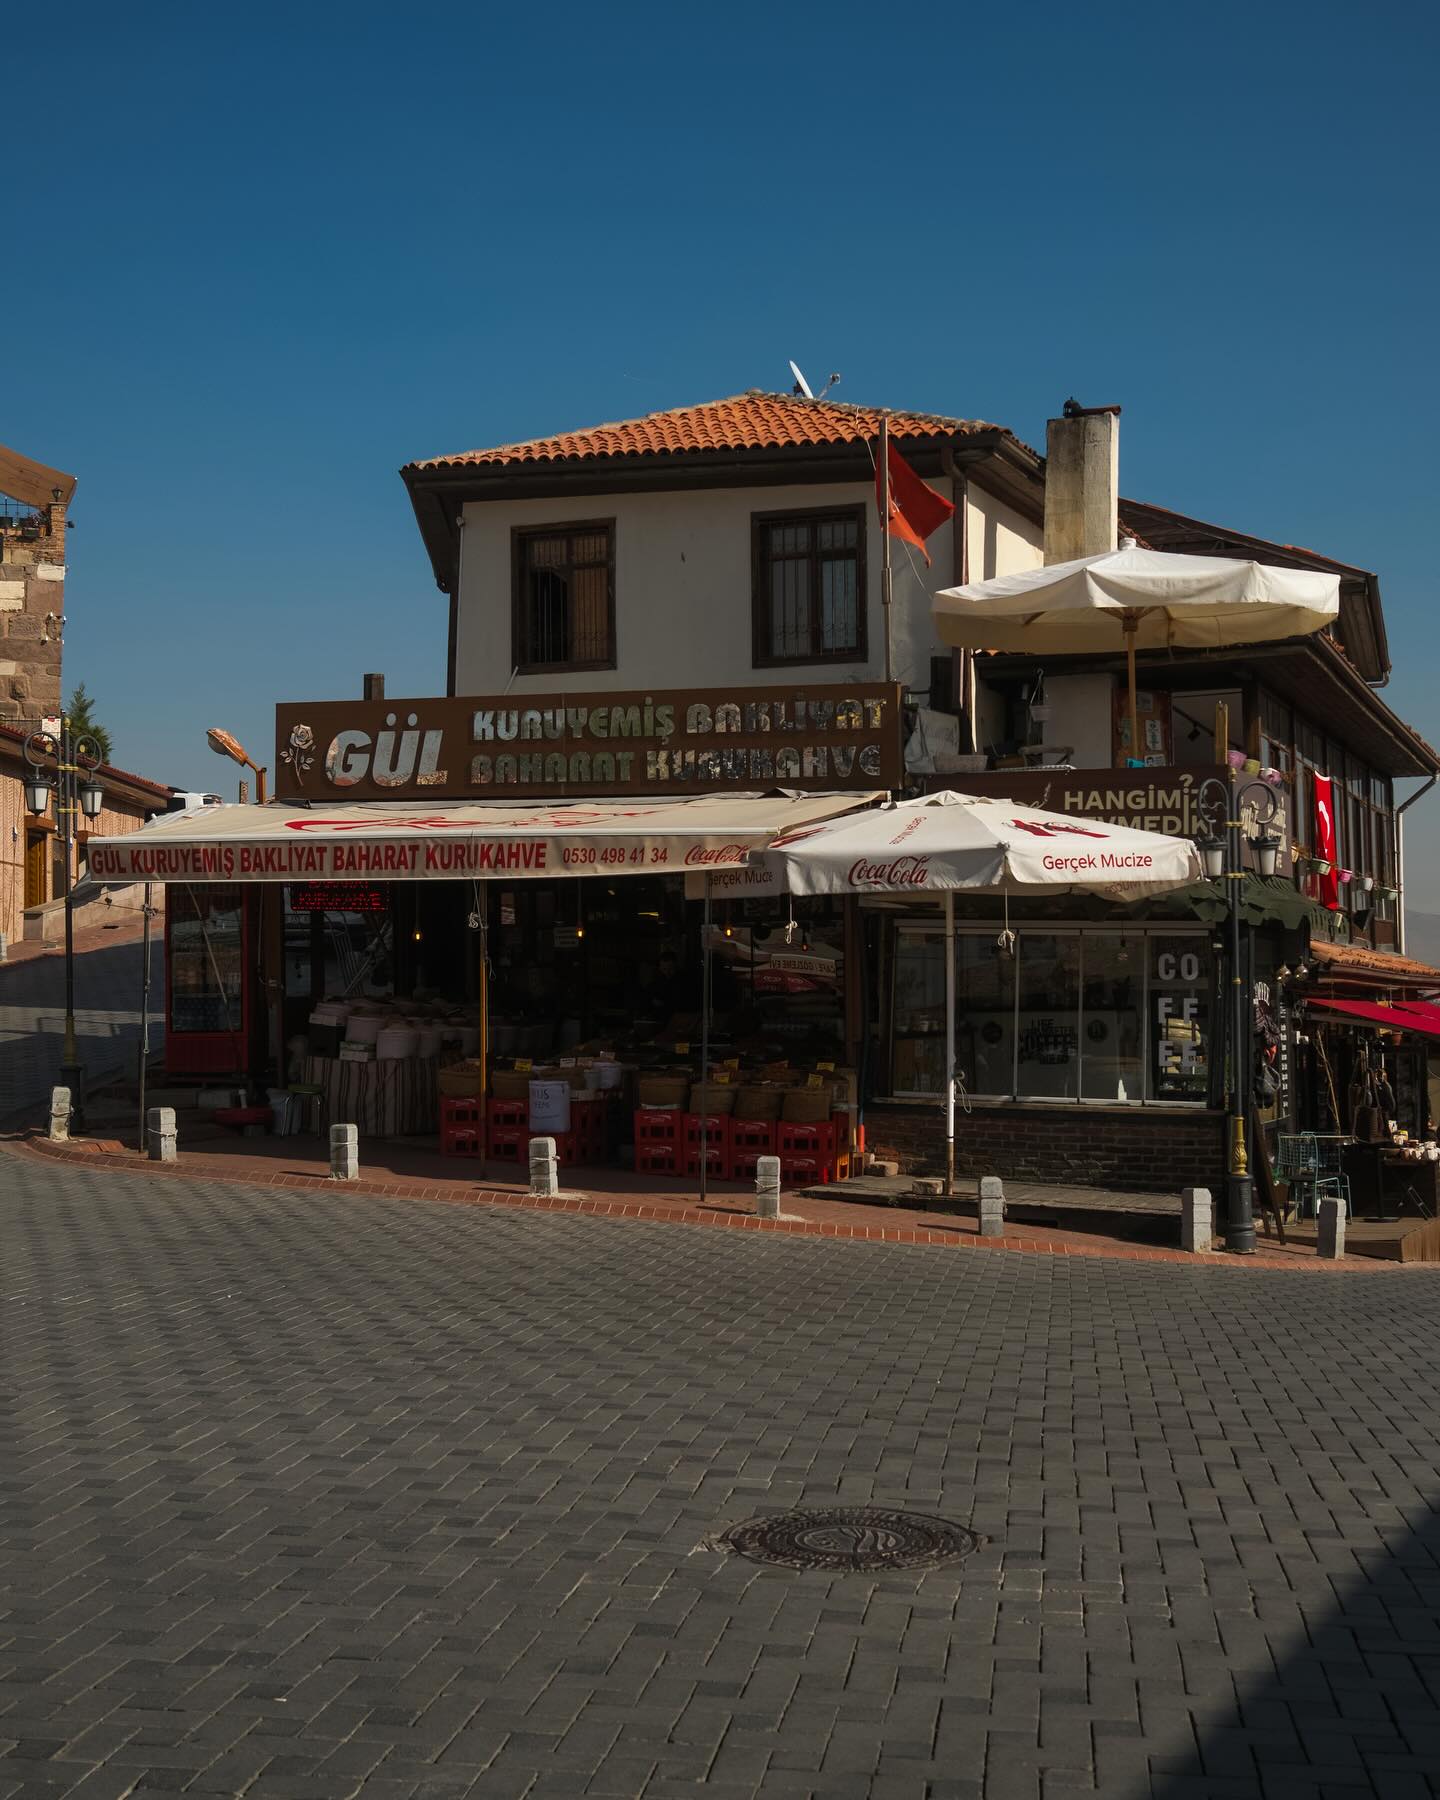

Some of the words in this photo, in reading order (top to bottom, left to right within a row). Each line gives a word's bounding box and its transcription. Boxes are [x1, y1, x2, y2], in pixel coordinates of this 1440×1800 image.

[473, 696, 675, 745] KURUYEMİŞ
[686, 692, 887, 734] BAKLİYAT
[324, 712, 449, 787] GÜL
[471, 751, 635, 785] BAHARAT
[646, 744, 881, 781] KURUKAHVE
[91, 844, 127, 875] GÜL
[130, 841, 235, 879] KURUYEMİŞ
[240, 840, 328, 873] BAKLİYAT
[333, 843, 420, 871] BAHARAT
[425, 842, 547, 870] KURUKAHVE
[562, 847, 596, 864] 0530
[600, 847, 625, 863] 498
[629, 847, 645, 863] 41
[650, 847, 668, 863] 34
[849, 855, 932, 887] Coca-Cola
[1042, 853, 1097, 874] Gerçek
[1101, 852, 1153, 868] Mucize
[1157, 952, 1200, 981] CO
